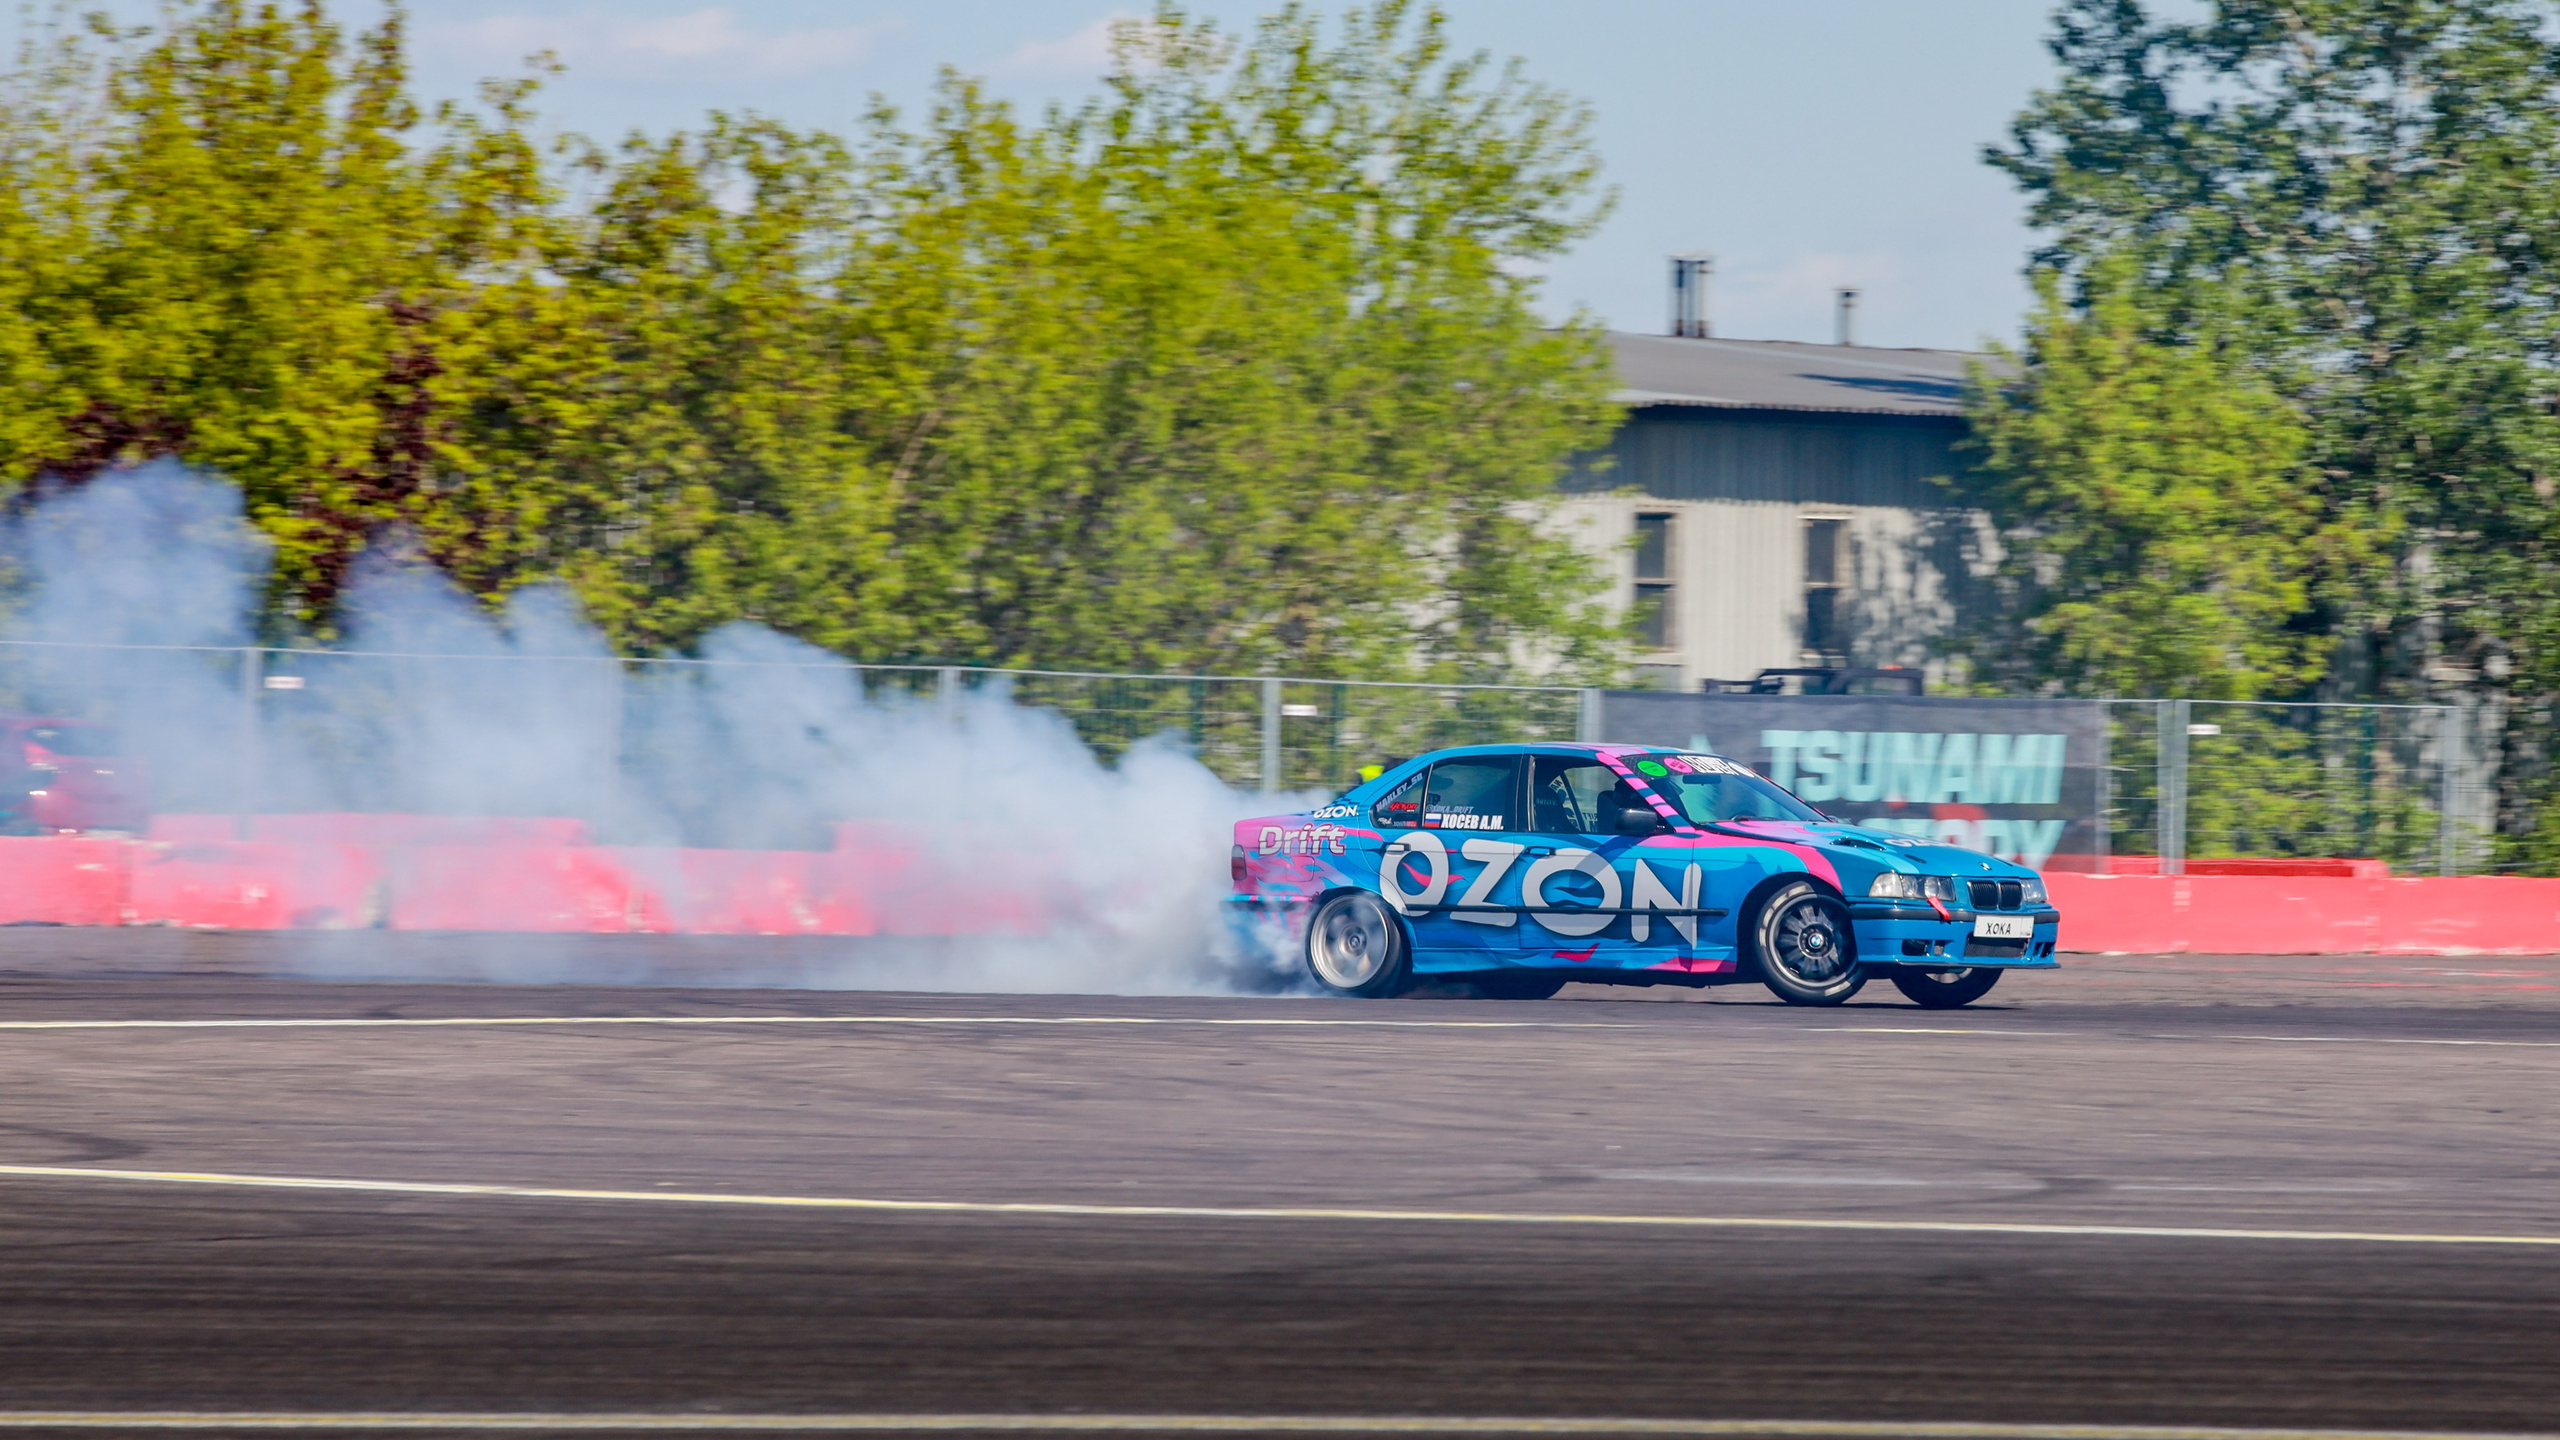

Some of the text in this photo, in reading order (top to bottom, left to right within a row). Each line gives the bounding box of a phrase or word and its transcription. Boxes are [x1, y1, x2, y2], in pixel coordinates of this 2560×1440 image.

[1761, 730, 2068, 804] TSUNAMI
[1258, 824, 1346, 855] Drift
[1379, 831, 1702, 949] OZON
